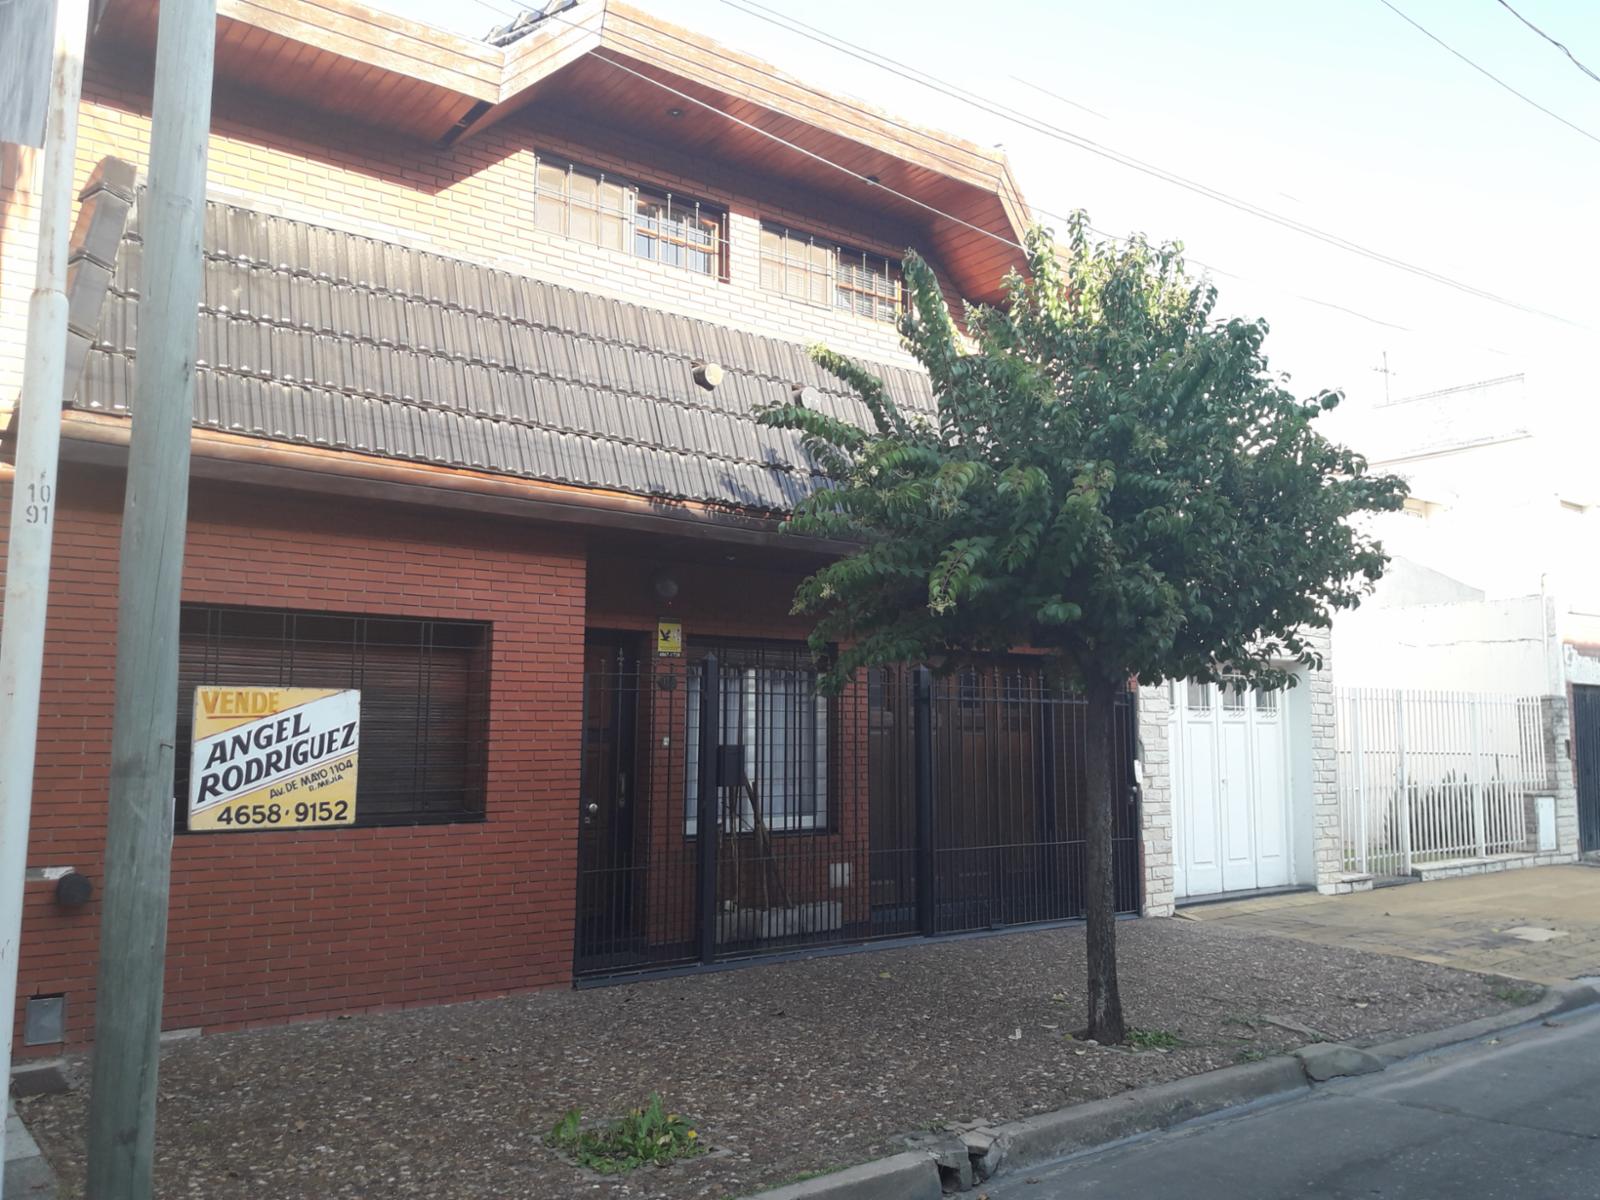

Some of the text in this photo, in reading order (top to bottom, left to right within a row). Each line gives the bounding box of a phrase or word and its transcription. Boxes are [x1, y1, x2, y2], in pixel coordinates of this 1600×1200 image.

[27, 483, 51, 503] 10
[26, 505, 48, 525] 91
[201, 690, 279, 714] VENDE
[203, 712, 311, 771] ANGEL
[196, 721, 357, 805] RODRIGUEZ
[285, 780, 298, 793] DE
[300, 769, 328, 787] MAYO
[329, 759, 353, 775] 1104
